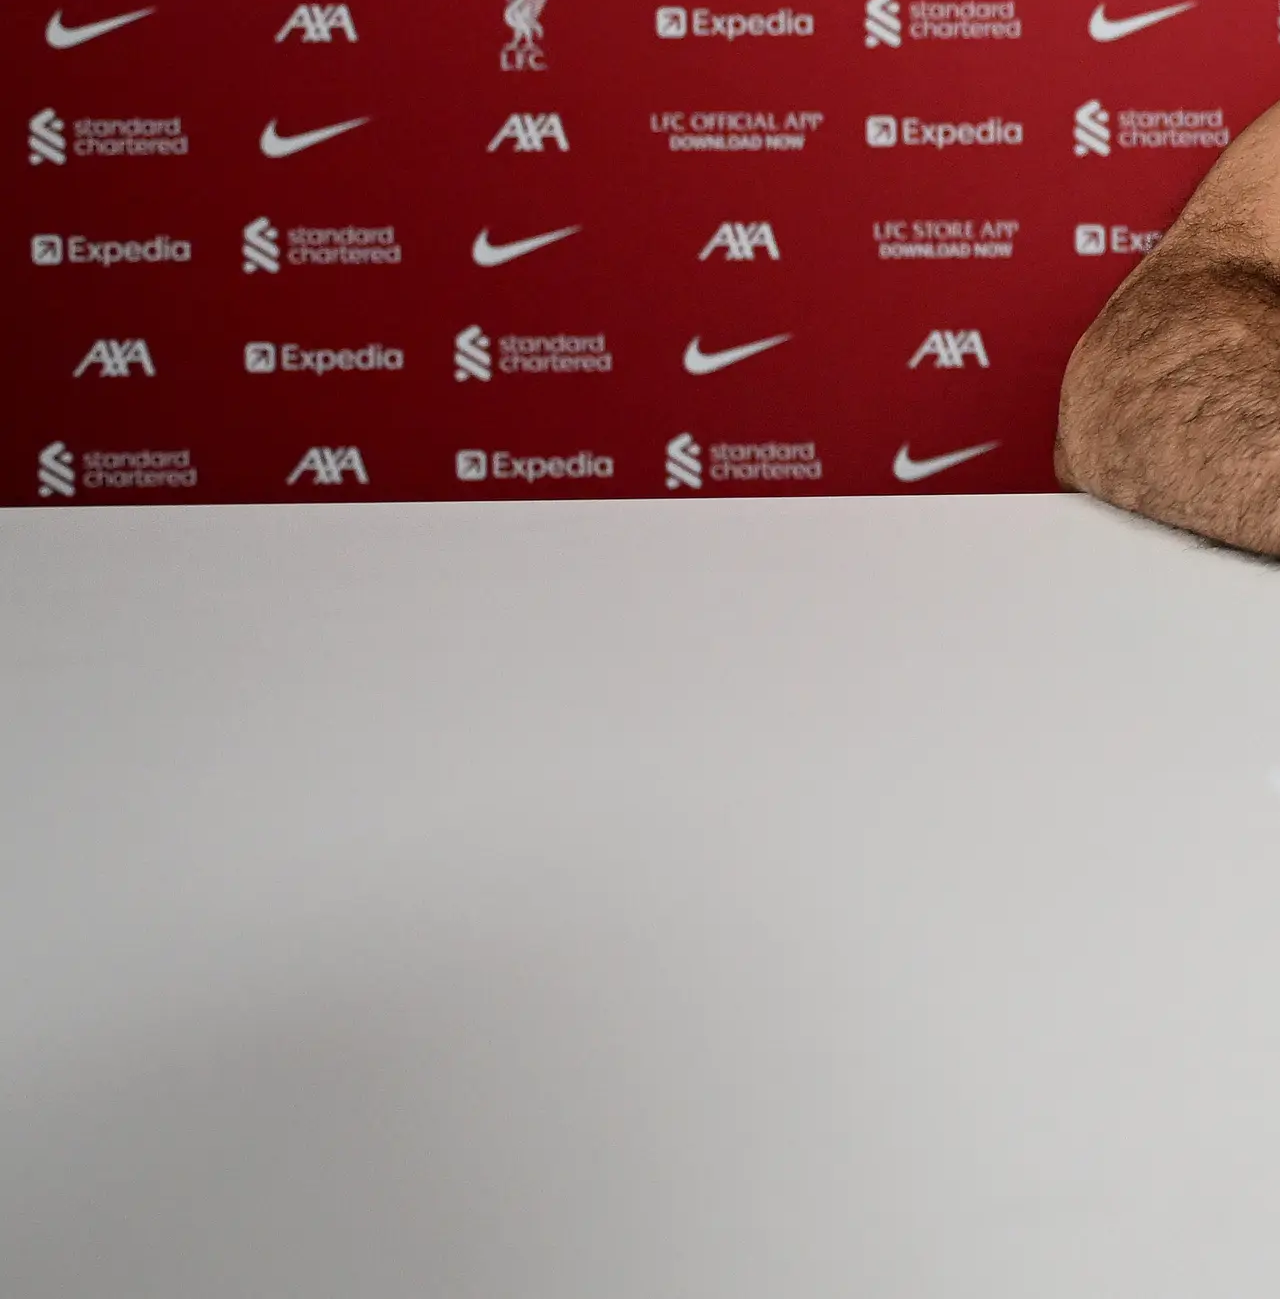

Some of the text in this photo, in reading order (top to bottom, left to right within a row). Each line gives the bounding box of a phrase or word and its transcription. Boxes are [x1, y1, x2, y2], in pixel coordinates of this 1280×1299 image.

[275, 4, 357, 42] AXA
[909, 0, 1014, 21] standard
[692, 8, 814, 41] Expedia
[909, 19, 1022, 39] chartered
[783, 111, 824, 131] APP
[902, 117, 1023, 149] Expedia
[669, 134, 805, 150] DOWNLOAD NOW
[699, 222, 780, 260] AXA
[498, 334, 604, 355] standard
[908, 330, 989, 368] AXA
[281, 344, 404, 375] Expedia
[499, 353, 612, 373] chartered
[709, 442, 814, 462] standard
[287, 447, 368, 484] AXA
[492, 451, 614, 483] Expedia
[709, 460, 822, 480] chartered
